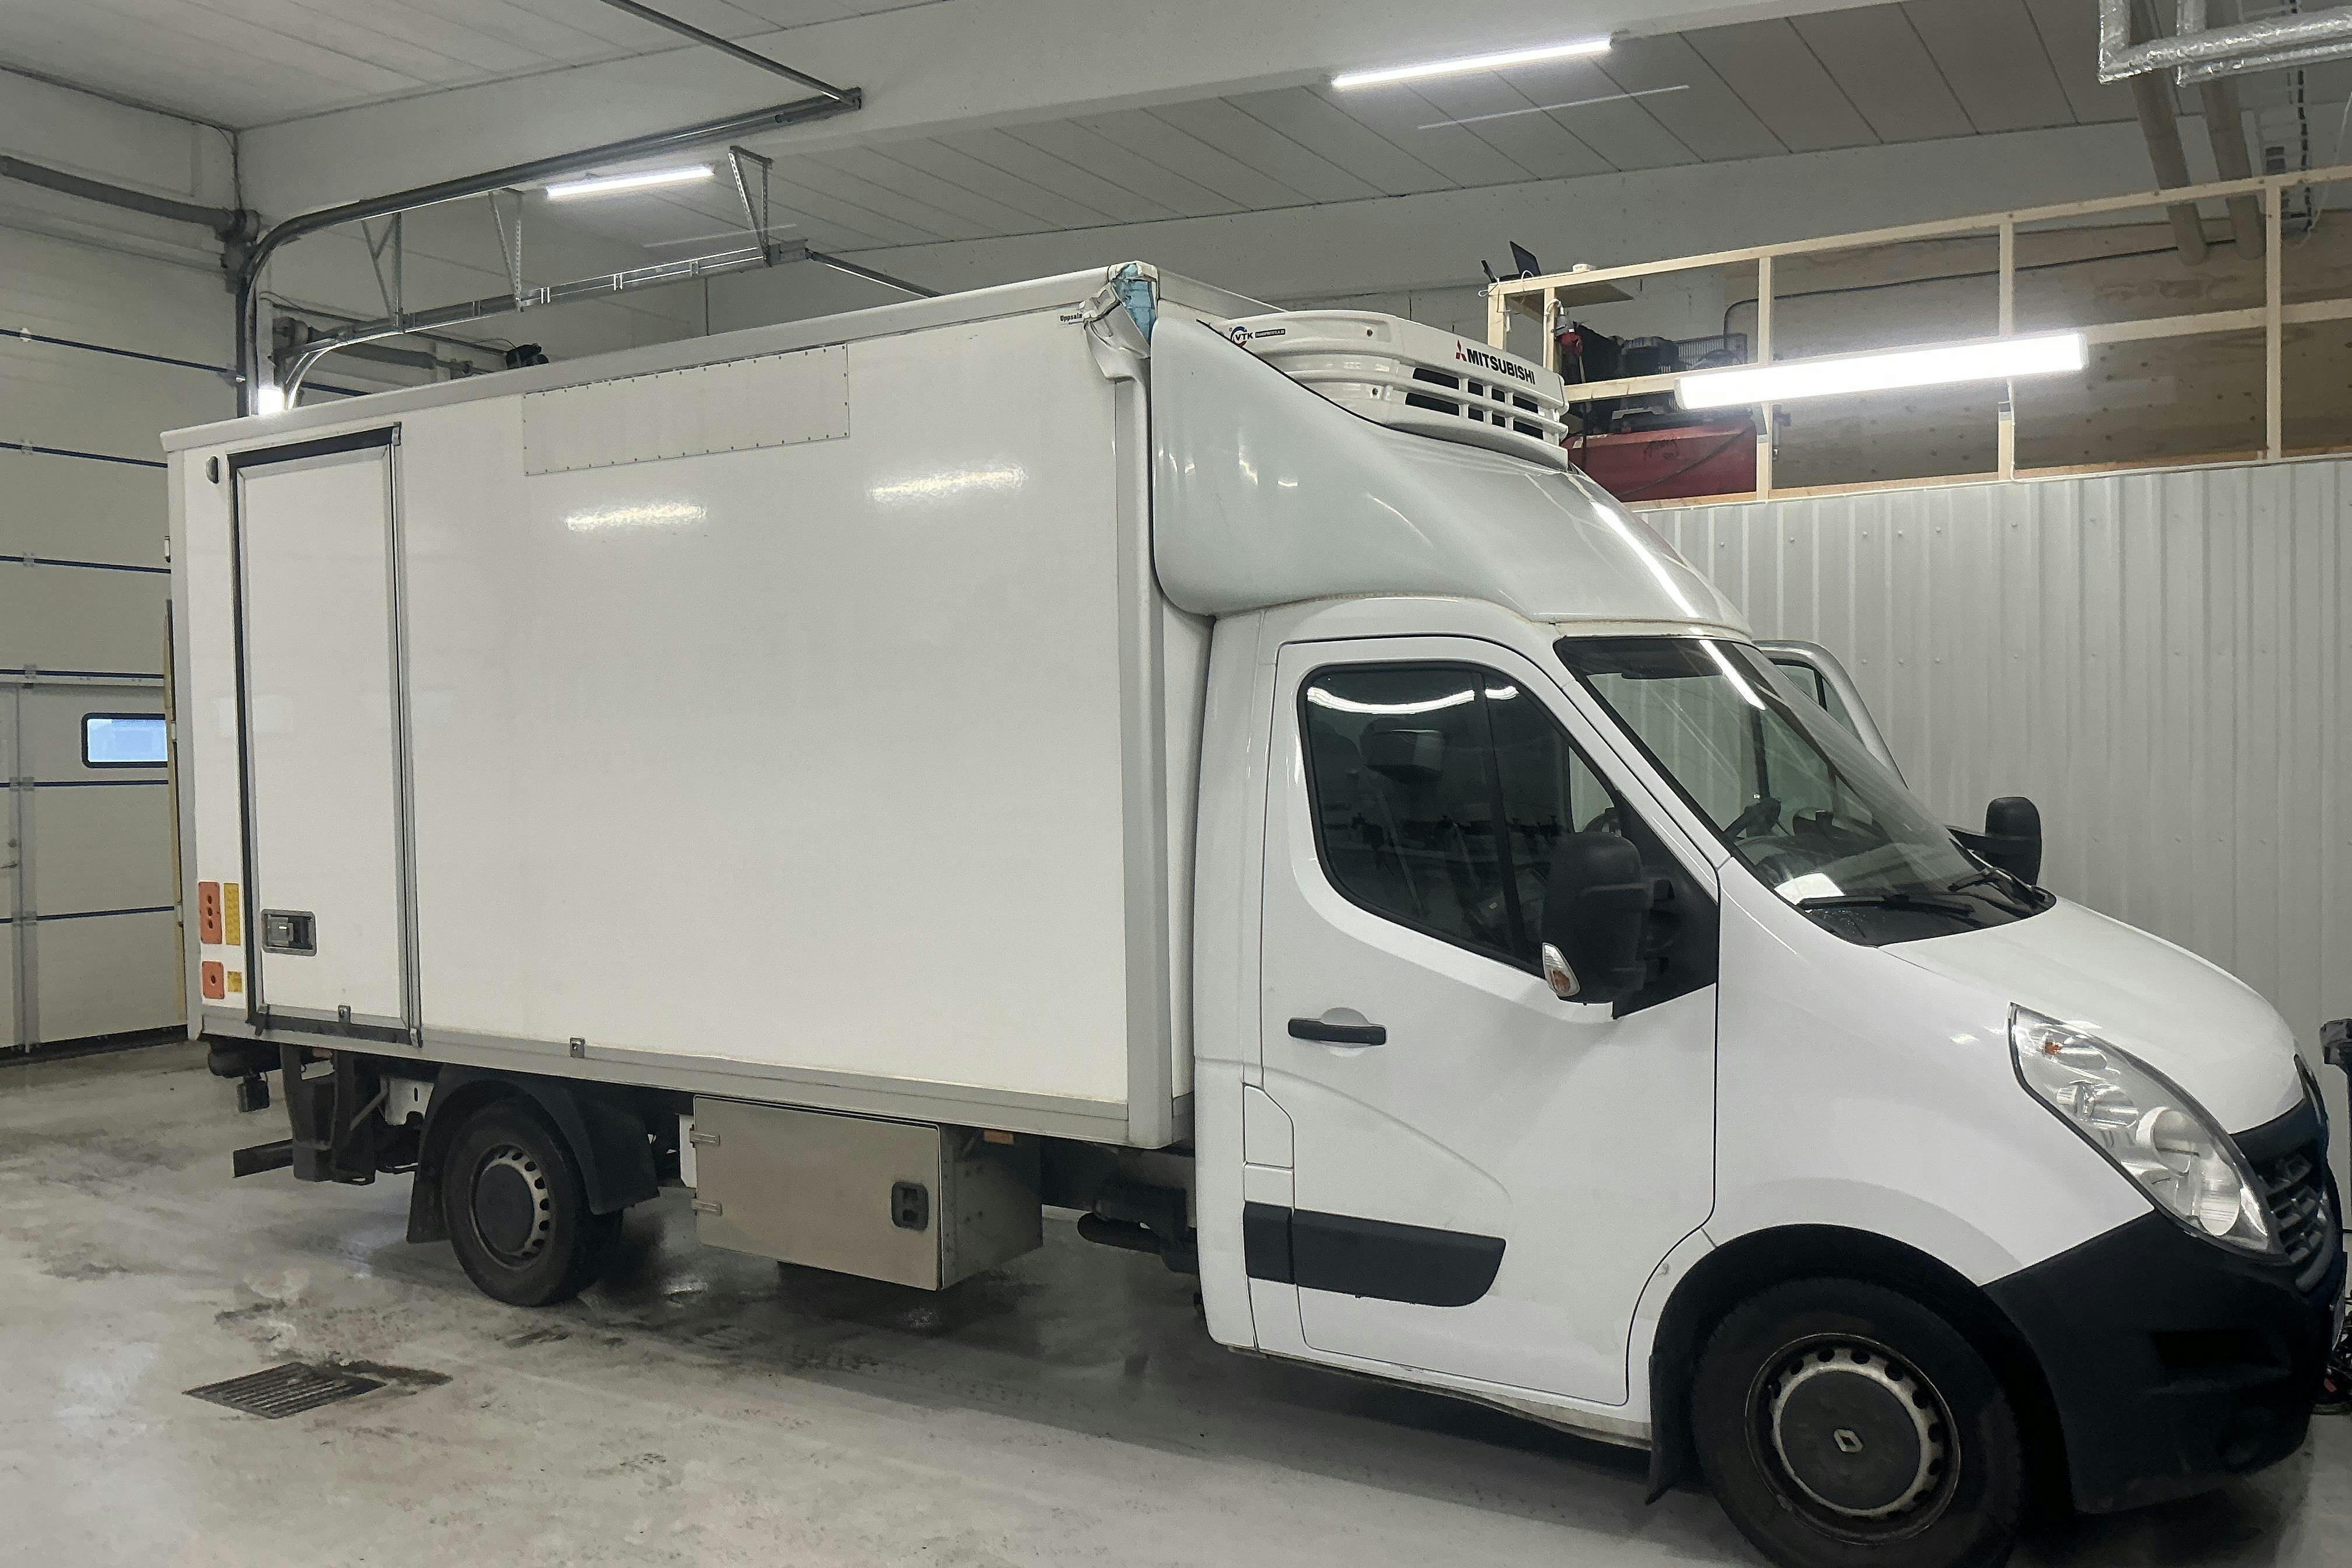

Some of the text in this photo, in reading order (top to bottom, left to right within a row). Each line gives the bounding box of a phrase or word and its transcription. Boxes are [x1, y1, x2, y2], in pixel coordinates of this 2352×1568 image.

[1060, 313, 1083, 322] Uppsala
[1235, 332, 1254, 341] VTK
[1466, 348, 1536, 385] MITSUBISHI
